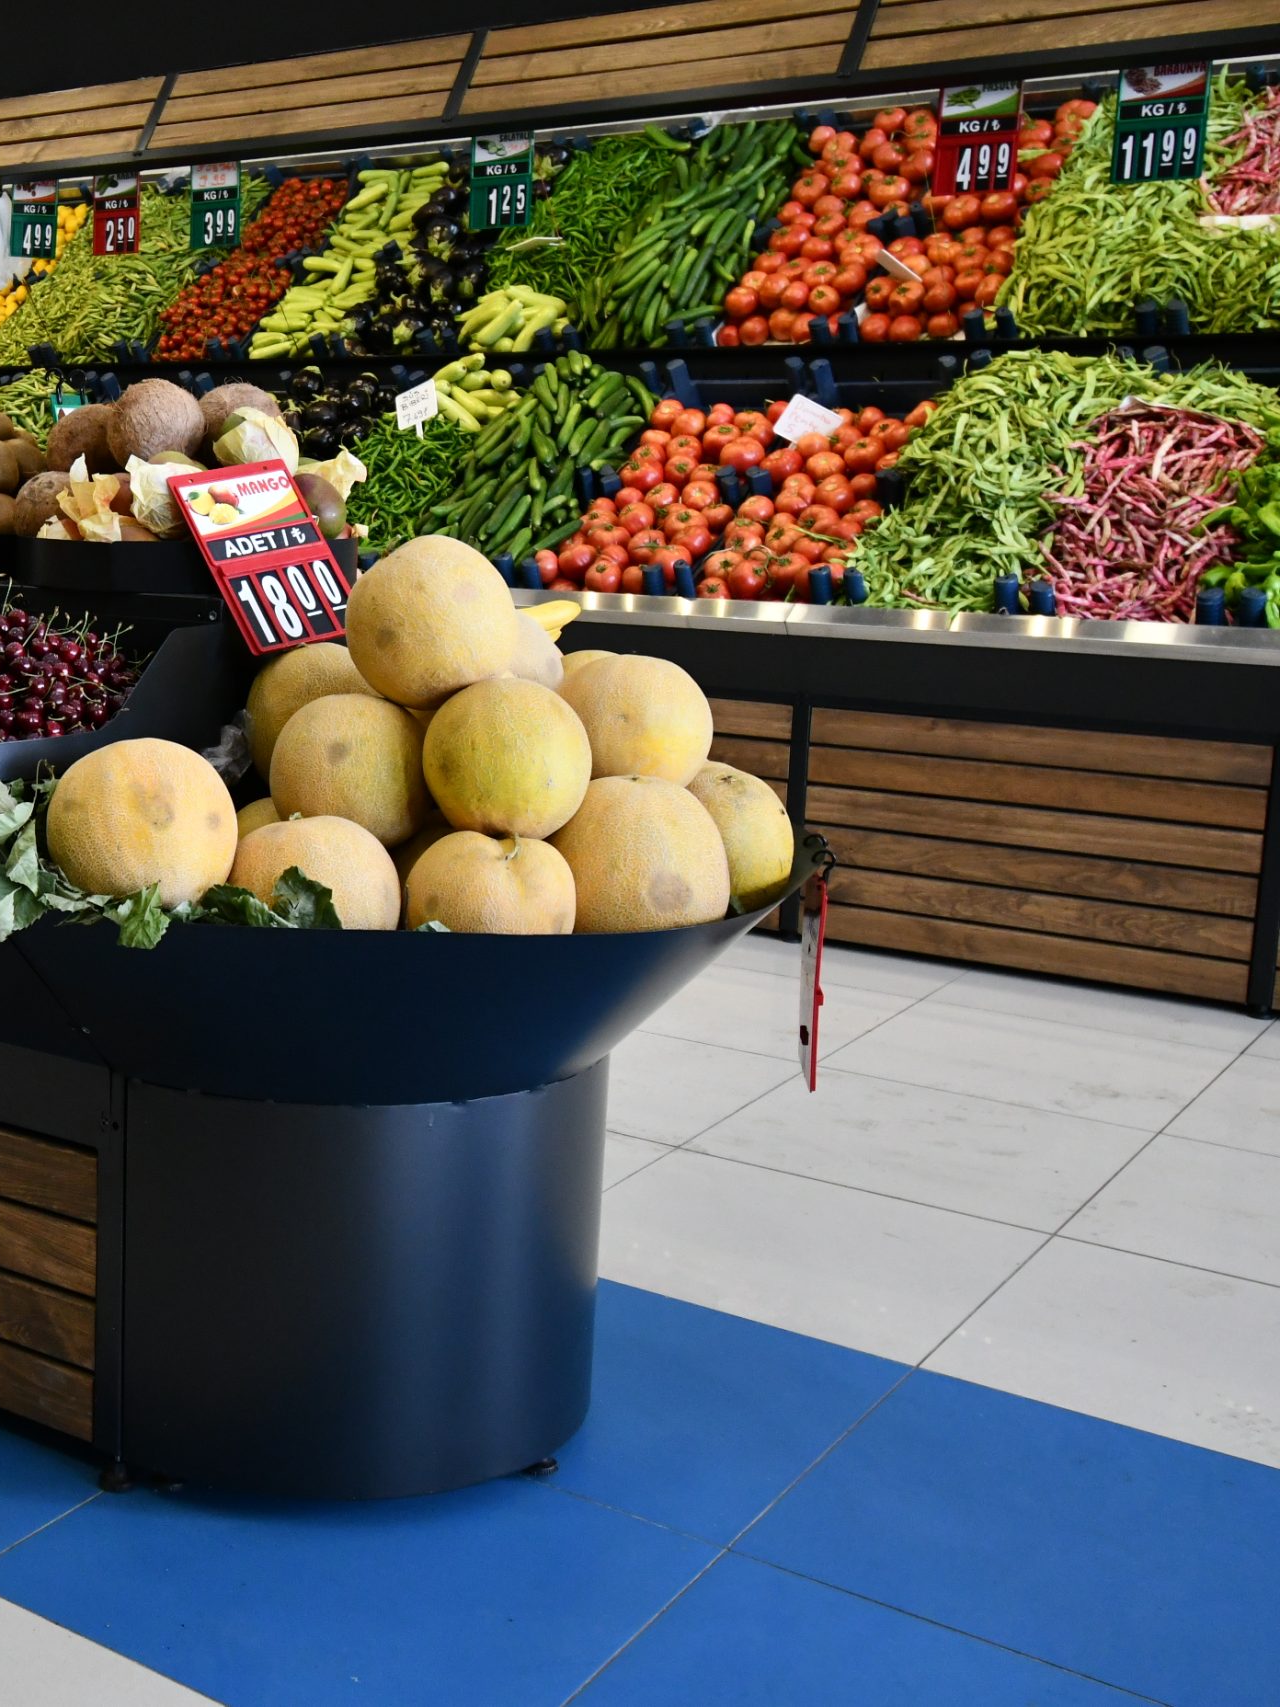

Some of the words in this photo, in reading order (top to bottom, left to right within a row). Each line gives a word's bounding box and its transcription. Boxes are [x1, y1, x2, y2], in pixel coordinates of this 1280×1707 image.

[1141, 104, 1164, 117] KG
[959, 121, 980, 133] KG
[956, 143, 1010, 190] 499
[1122, 128, 1197, 179] 1199
[486, 165, 502, 175] KG
[105, 200, 118, 209] KG
[204, 191, 217, 200] KG
[488, 184, 526, 225] 125
[24, 205, 36, 213] KG
[22, 224, 52, 255] 499
[105, 217, 135, 252] 250
[204, 209, 235, 245] 399
[236, 476, 291, 497] MANGO
[225, 532, 276, 558] ADET
[237, 560, 342, 643] 1800
